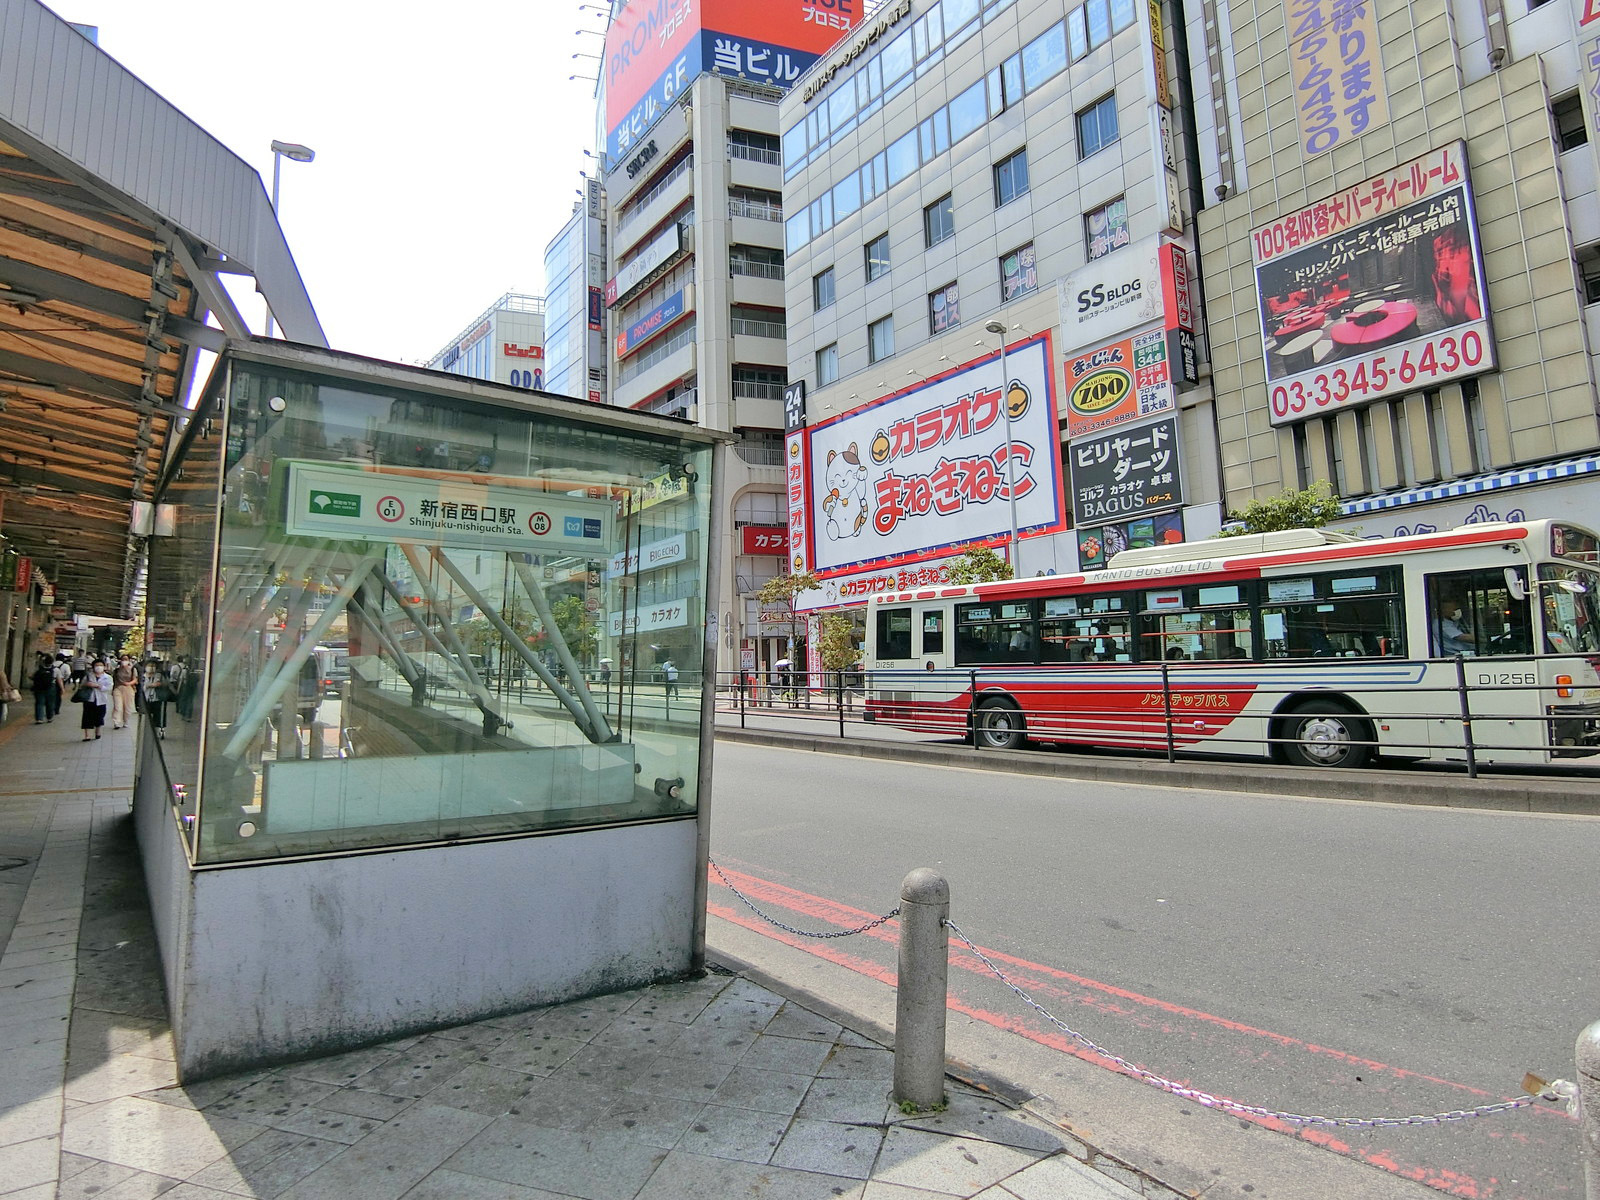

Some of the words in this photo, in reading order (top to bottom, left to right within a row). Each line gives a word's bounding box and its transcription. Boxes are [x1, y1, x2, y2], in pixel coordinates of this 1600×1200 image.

[659, 0, 691, 48] プロミス
[802, 7, 852, 31] プロミス
[611, 0, 680, 86] PROMI
[714, 39, 800, 80] 当ビル
[617, 96, 656, 153] 当ビル
[664, 56, 686, 102] 6F
[1253, 150, 1459, 261] 100名収容大パーティールーム
[1331, 195, 1459, 254] パーティールーム内
[1077, 283, 1105, 313] SS
[1107, 278, 1141, 302] BLDG
[1174, 252, 1190, 324] カラオケ
[633, 310, 663, 341] PROMISE
[504, 342, 544, 359] ビック
[1272, 330, 1483, 417] 03-3345-6430
[785, 386, 802, 412] 24
[1079, 377, 1124, 406] ZOO
[1140, 392, 1158, 404] 日本
[788, 410, 800, 428] H
[889, 388, 1003, 460] カラオケ
[1077, 425, 1168, 467] ビリヤード
[1113, 449, 1170, 482] ダーツ
[872, 442, 1036, 535] まねきねこ
[1079, 488, 1105, 502] ゴルフ
[1110, 479, 1145, 495] カラオケ
[1150, 472, 1172, 486] 卓球
[383, 508, 396, 517] 01
[388, 500, 394, 508] E
[420, 499, 516, 525] 新宿西口駅
[788, 465, 804, 551] カラオケ
[1083, 492, 1144, 518] BAGUS
[409, 517, 505, 534] Shinjuku-nishiguchi
[507, 526, 524, 535] Sta.
[534, 522, 546, 531] 08
[536, 515, 544, 523] M
[662, 544, 680, 556] ECHO
[754, 534, 788, 548] カラ
[847, 576, 887, 595] カラオケ
[1093, 568, 1132, 581] KANTO
[651, 607, 681, 623] カラオケ
